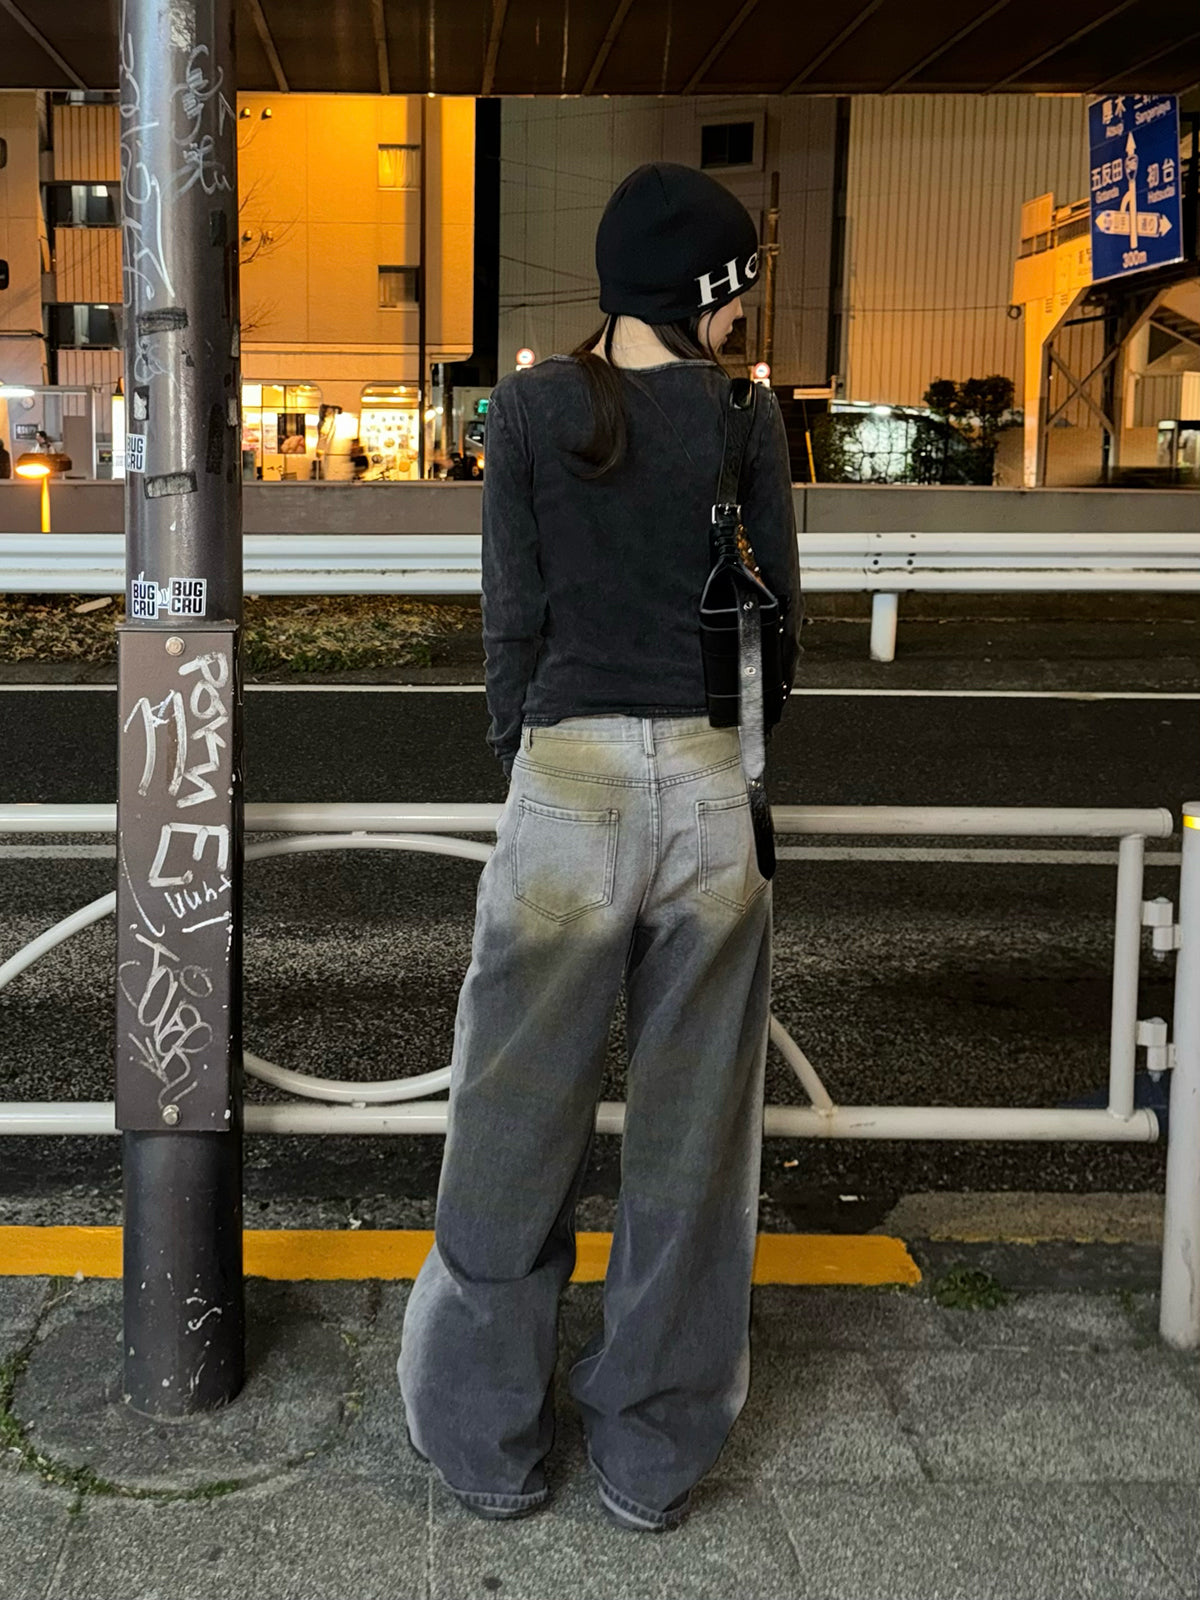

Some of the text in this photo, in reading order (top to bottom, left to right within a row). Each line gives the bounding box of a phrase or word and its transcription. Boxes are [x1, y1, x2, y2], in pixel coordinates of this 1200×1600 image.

[1091, 157, 1123, 191] 五反田
[1147, 158, 1176, 189] 初台
[1122, 250, 1147, 269] 300m
[133, 583, 155, 600] BUG
[173, 581, 203, 597] BUG
[133, 600, 155, 616] CRU
[171, 597, 203, 614] CRU
